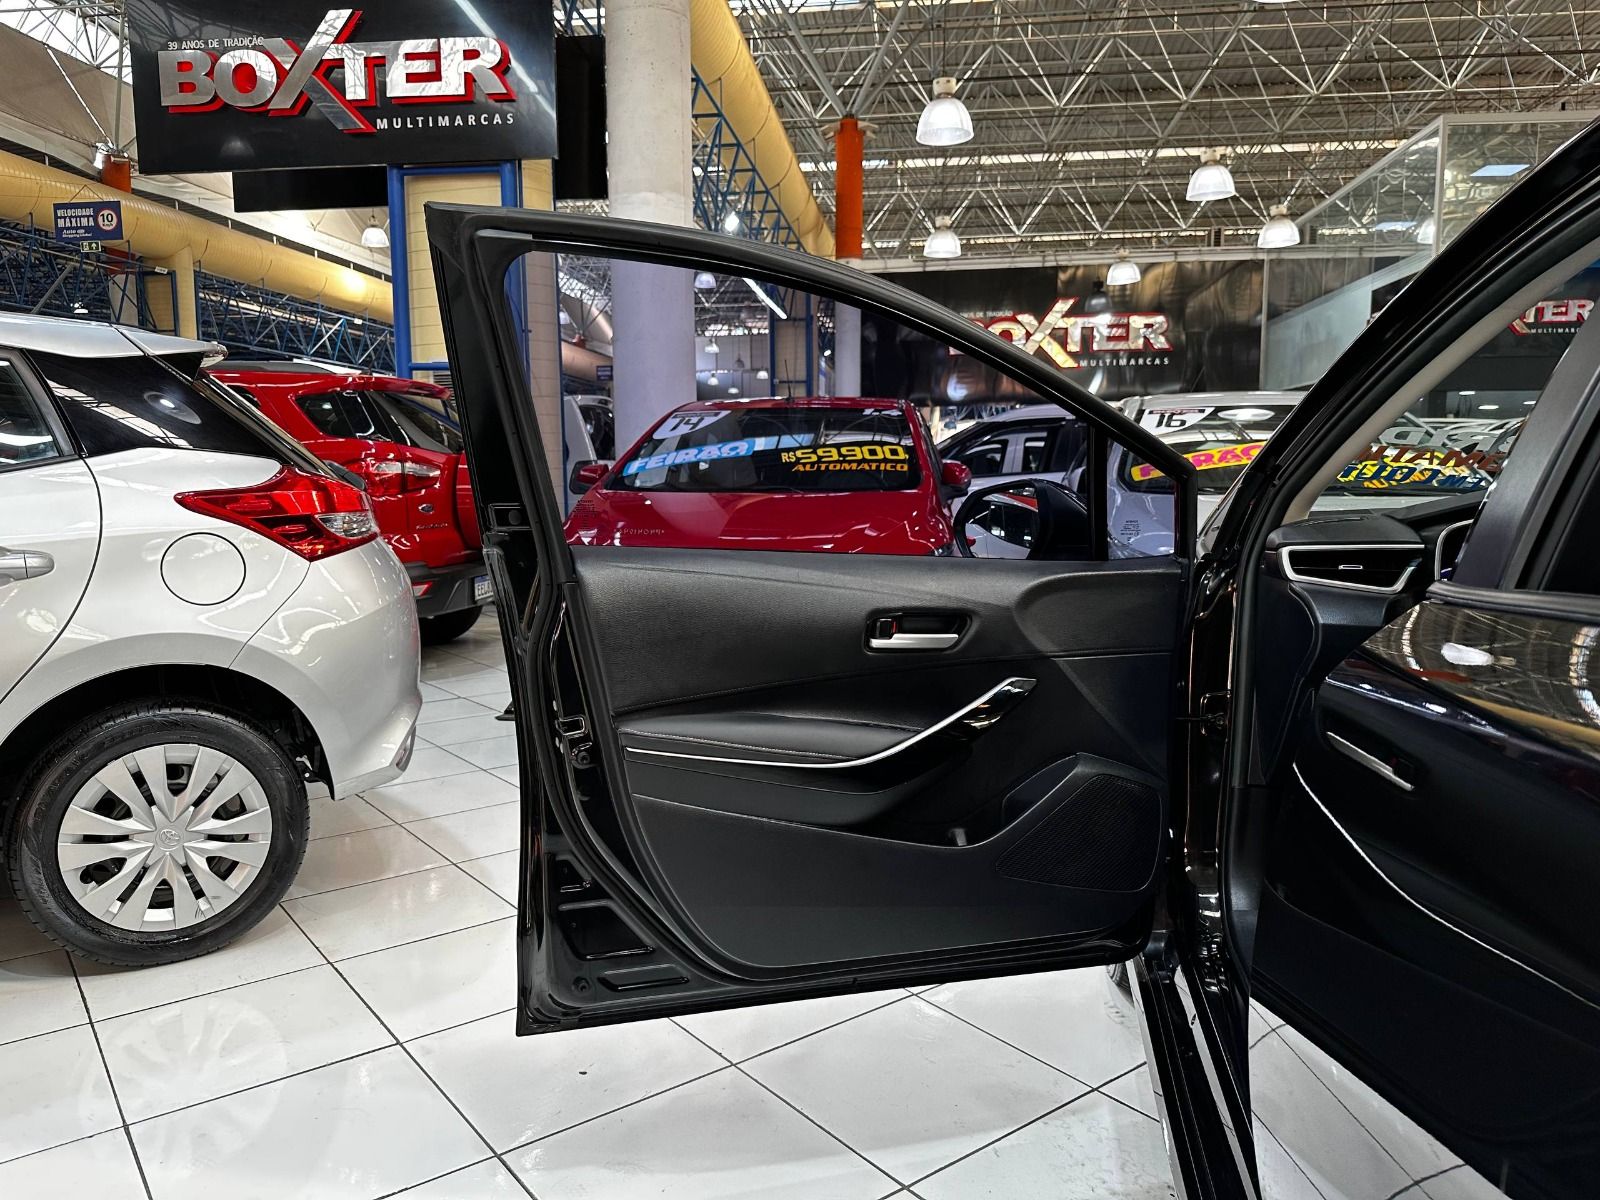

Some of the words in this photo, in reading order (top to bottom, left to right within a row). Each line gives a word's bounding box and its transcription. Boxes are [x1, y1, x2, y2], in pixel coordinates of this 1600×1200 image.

[167, 41, 178, 50] 39
[182, 40, 205, 50] ANOS
[208, 38, 220, 48] DE
[222, 35, 264, 48] TRADIÇÃO
[157, 8, 515, 133] BOXTER
[376, 113, 515, 130] MULTIMARCAS
[56, 208, 94, 217] VELOCIDADE
[100, 213, 114, 223] 10
[57, 216, 95, 228] MÁXIMA
[949, 298, 1173, 369] OXTER
[1079, 358, 1170, 367] MULTIMARCAS
[669, 416, 705, 432] 14
[1155, 413, 1187, 428] 16
